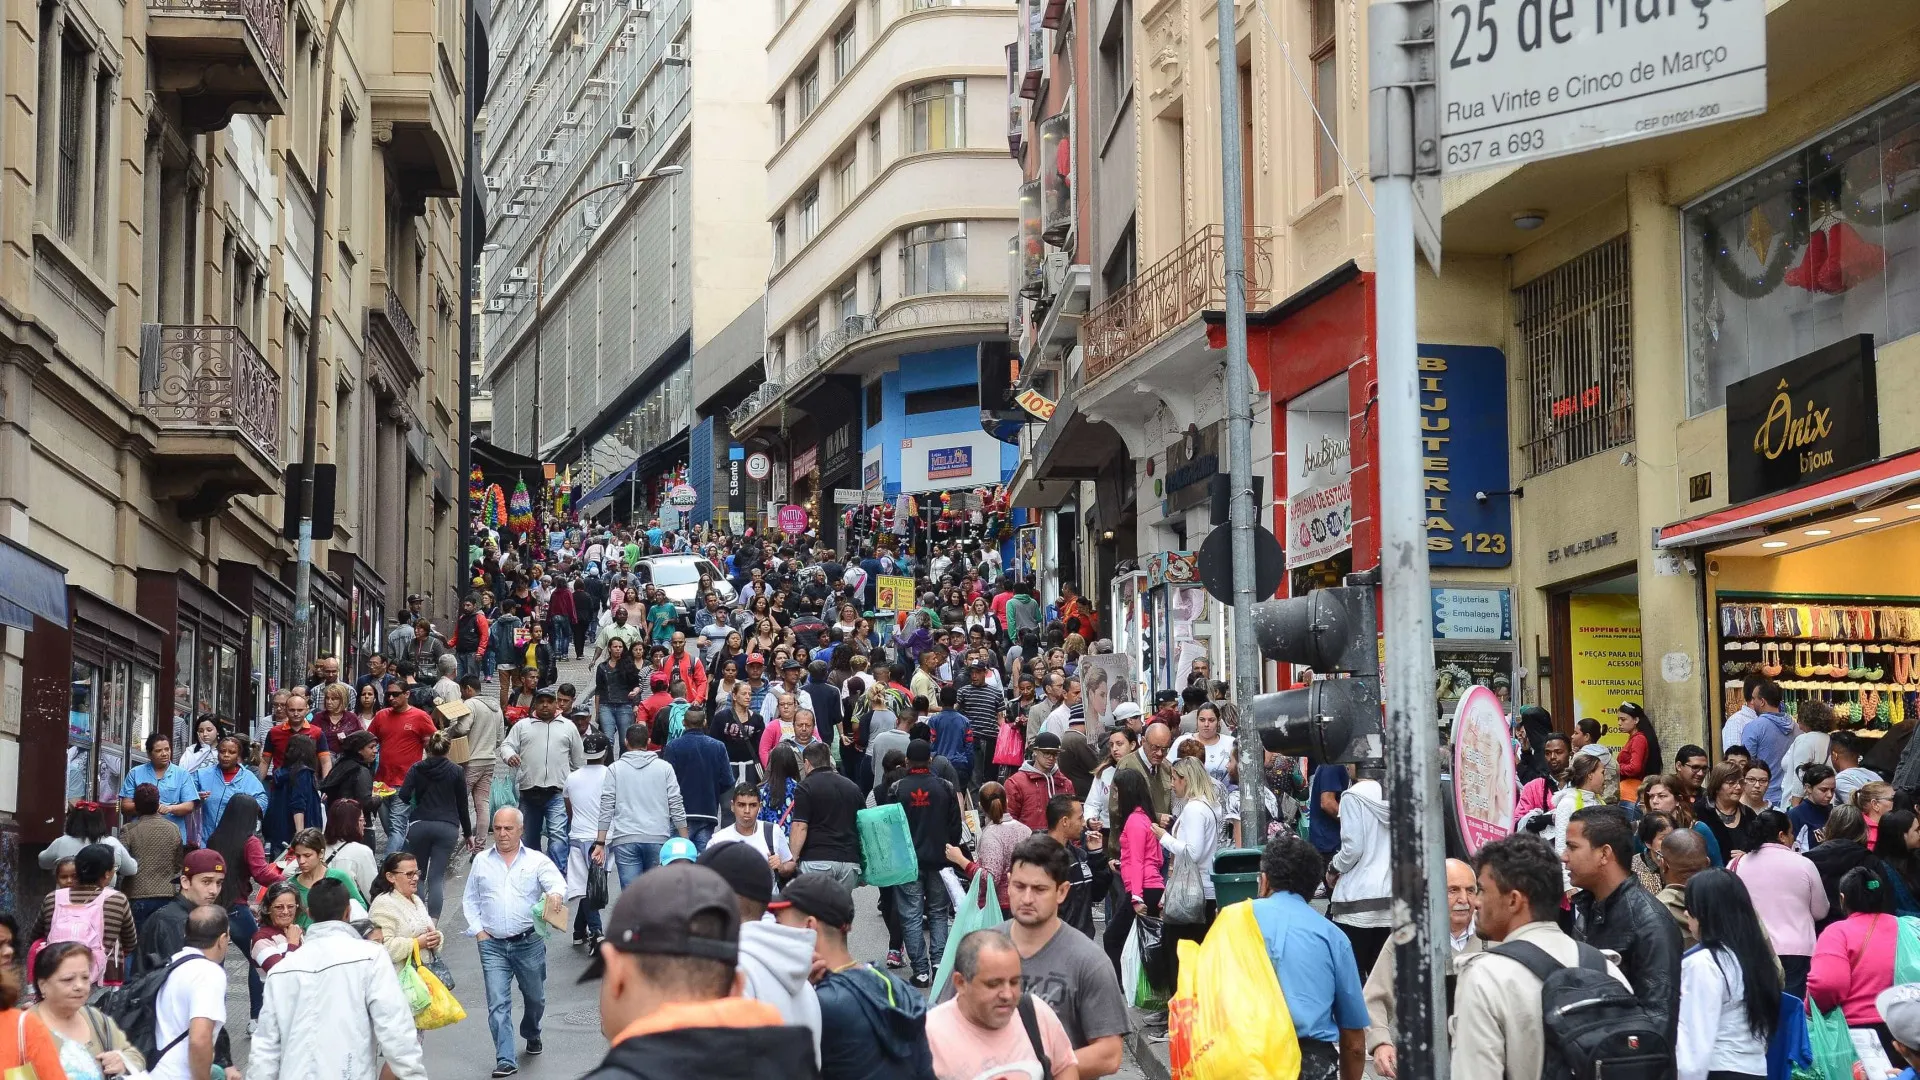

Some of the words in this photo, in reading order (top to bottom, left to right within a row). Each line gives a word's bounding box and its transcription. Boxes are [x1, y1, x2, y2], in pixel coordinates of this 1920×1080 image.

[1450, 0, 1498, 70] 25
[1517, 0, 1574, 52] de
[1447, 101, 1485, 123] Rua
[1492, 89, 1541, 113] Vinte
[1548, 86, 1559, 102] e
[1566, 72, 1623, 98] Cinco
[1630, 60, 1655, 84] de
[1662, 46, 1727, 76] Março
[1635, 117, 1660, 132] CEP
[1661, 103, 1720, 127] 01021-200
[1447, 140, 1483, 165] 637
[1489, 142, 1501, 158] a
[1508, 129, 1545, 154] 693
[1022, 391, 1056, 418] 103
[1754, 378, 1833, 460] Ônix
[750, 457, 767, 470] GJ
[1417, 357, 1455, 551] BIJUTERIAS
[730, 461, 739, 496] S.Bento
[1690, 474, 1711, 499] 127
[1461, 532, 1507, 554] 123
[1452, 596, 1489, 604] Bijuterias
[1452, 610, 1500, 618] Embalagens
[1454, 625, 1473, 633] Semi
[1585, 651, 1607, 659] PEÇAS
